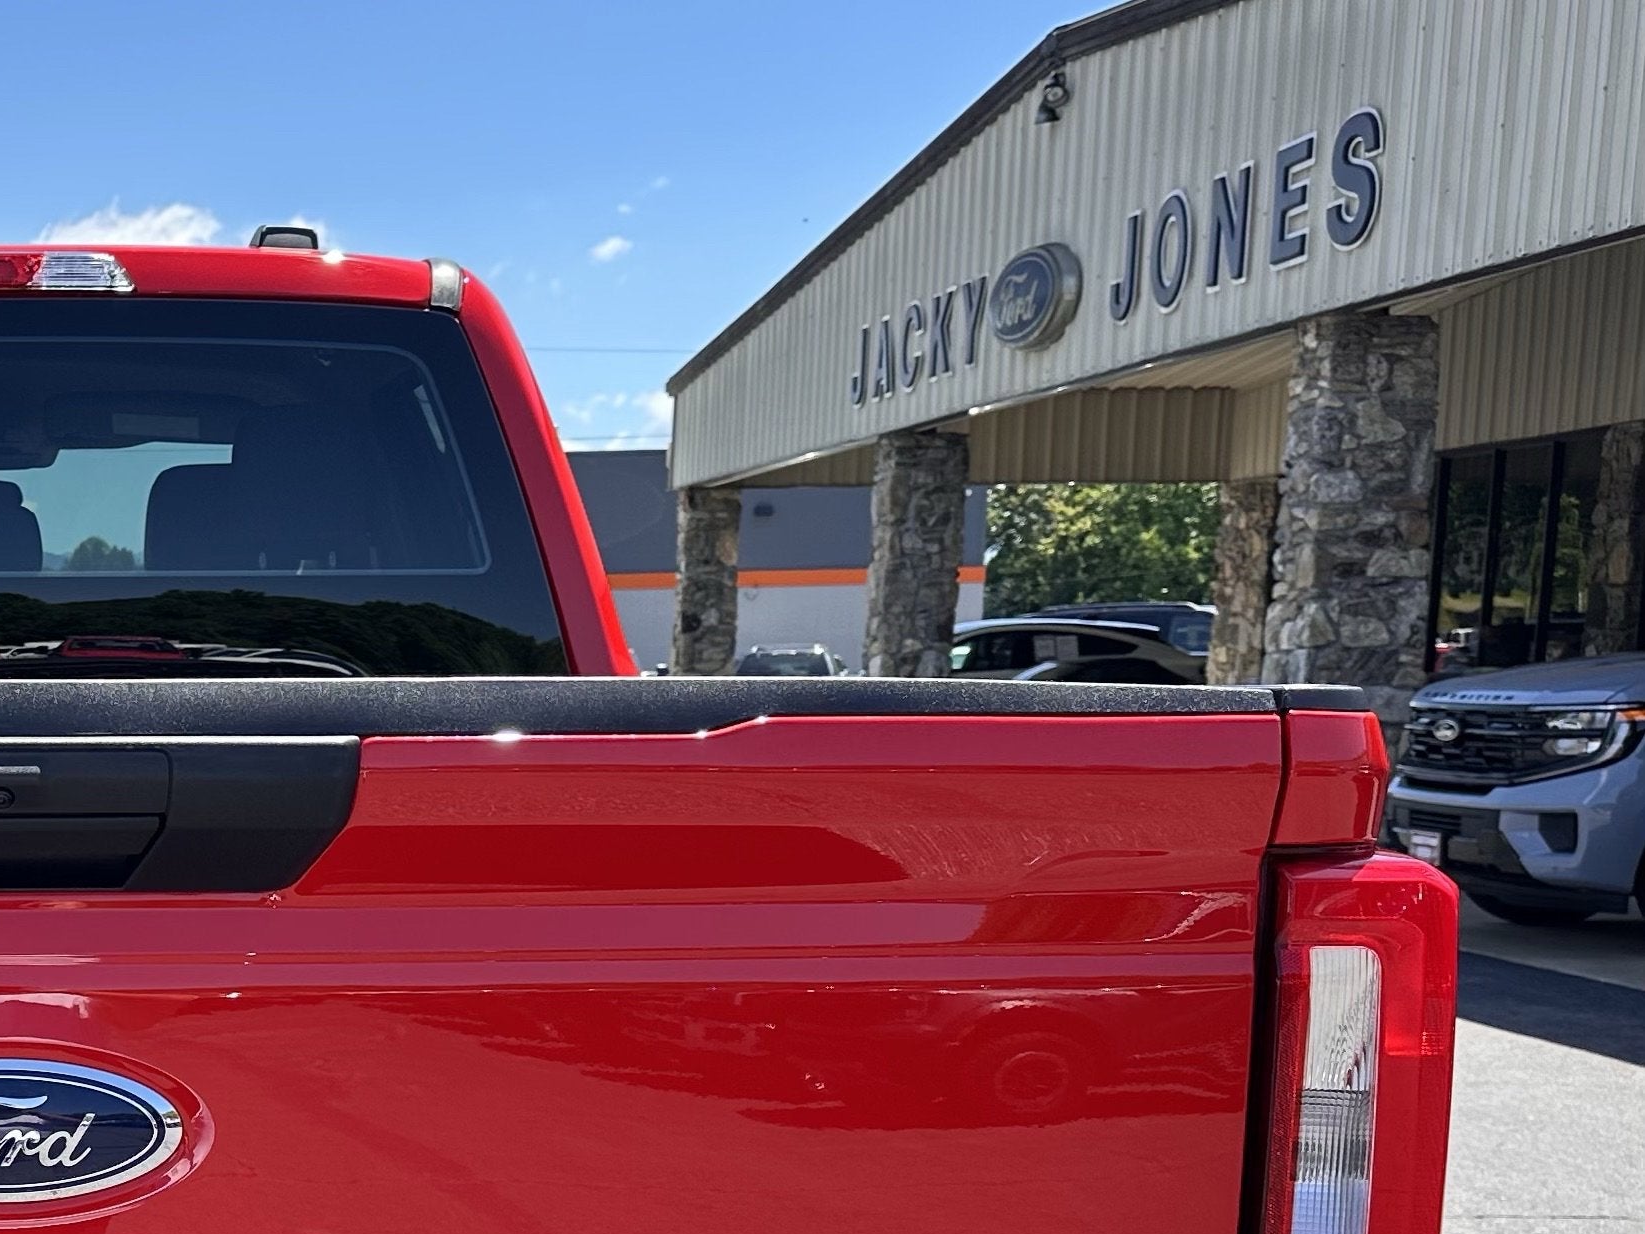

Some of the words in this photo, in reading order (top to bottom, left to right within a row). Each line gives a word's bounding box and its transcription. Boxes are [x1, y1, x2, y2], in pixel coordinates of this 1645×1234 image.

[851, 273, 989, 408] JACKY
[1108, 105, 1386, 326] JONES
[995, 271, 1039, 330] Ford
